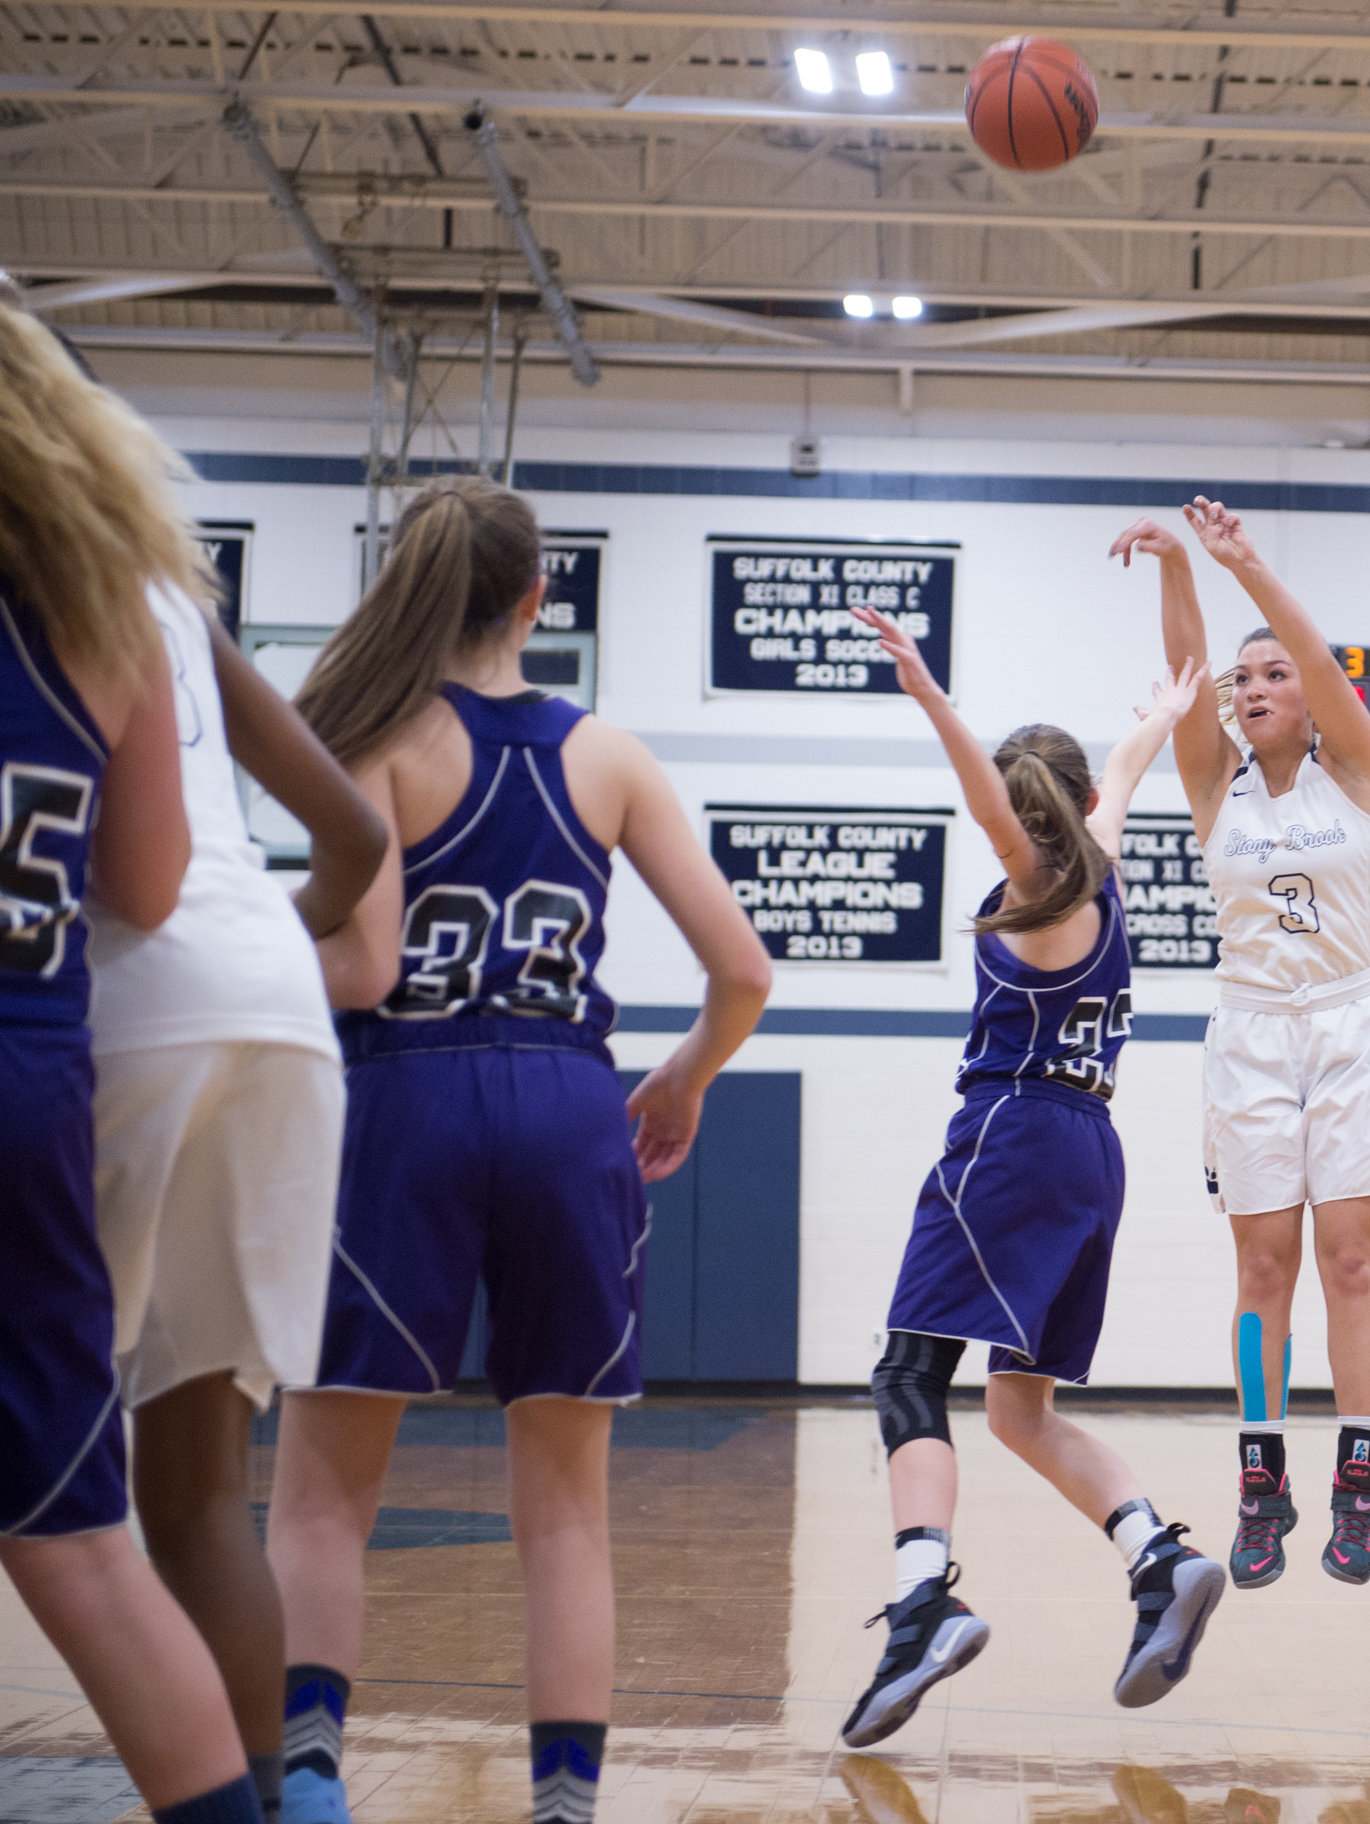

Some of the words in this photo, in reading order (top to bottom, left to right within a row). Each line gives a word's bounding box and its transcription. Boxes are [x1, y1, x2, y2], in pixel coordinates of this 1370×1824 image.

[732, 556, 835, 581] SUFFOLK
[842, 560, 933, 585] COUNTY
[744, 582, 811, 606] SECTION
[819, 585, 840, 607] XI
[846, 585, 900, 608] CLASS
[750, 638, 817, 661] GIRLS
[795, 663, 869, 688] 2013
[729, 825, 830, 849] SUFFOLK
[837, 827, 927, 851] COUNTY
[1223, 828, 1277, 864] Stony
[1285, 818, 1347, 851] Brook
[757, 850, 897, 880] LEAGUE
[732, 880, 924, 909] CHAMPIONS
[1268, 872, 1321, 934] 3
[753, 910, 813, 933] BOYS
[818, 910, 898, 934] TENNIS
[787, 935, 863, 959] 2013
[1138, 938, 1212, 962] 2013
